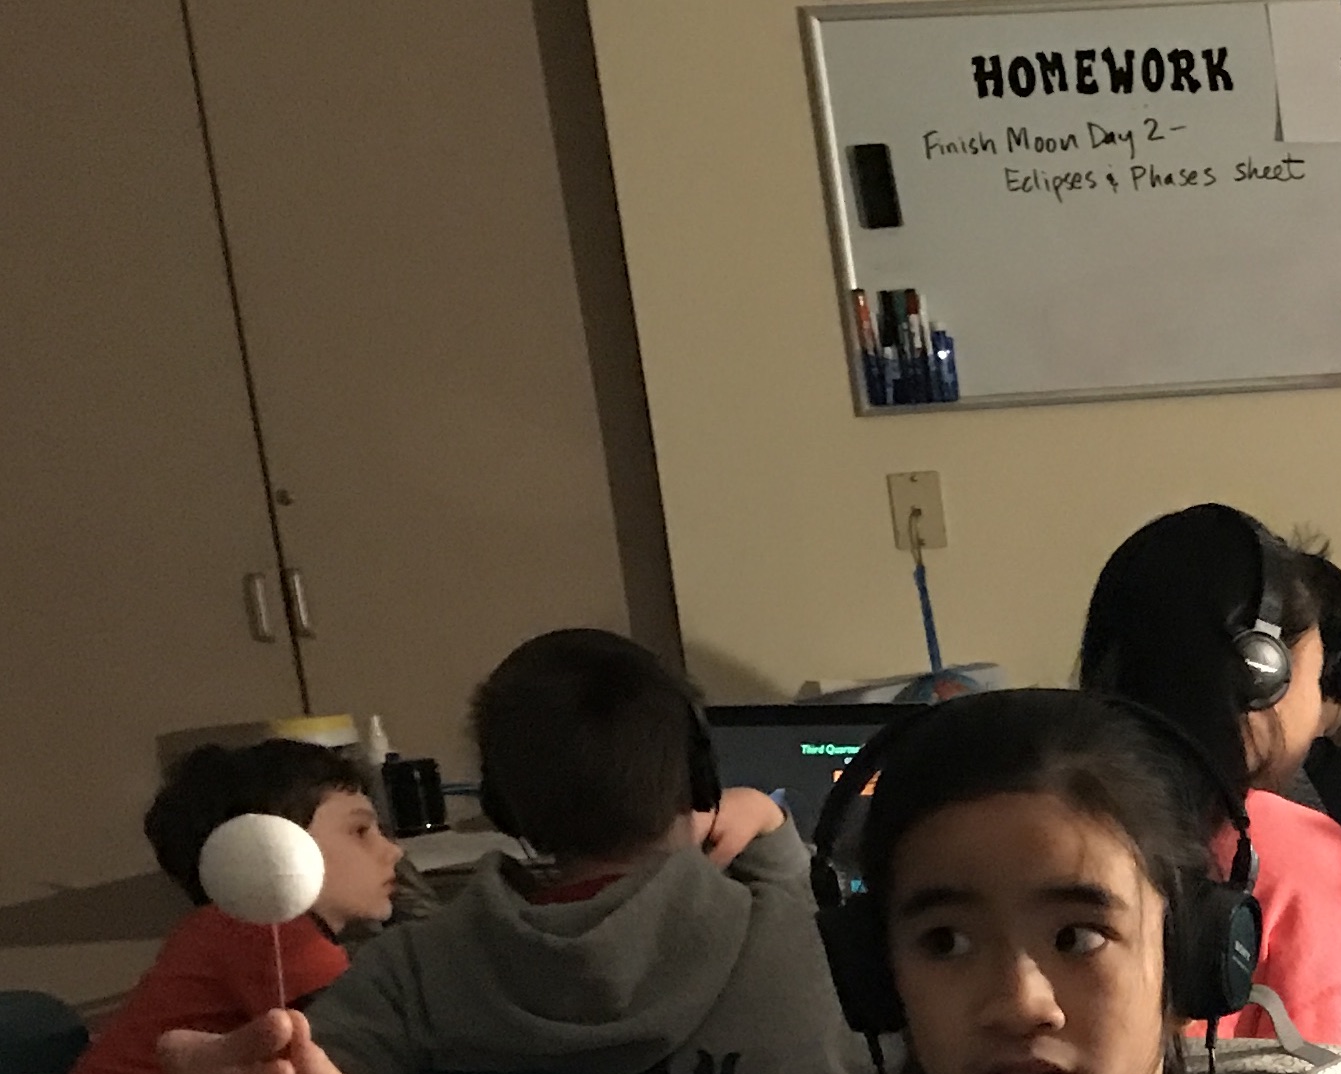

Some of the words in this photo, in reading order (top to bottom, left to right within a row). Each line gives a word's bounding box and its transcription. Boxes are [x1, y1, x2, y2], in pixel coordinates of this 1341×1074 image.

[971, 47, 1234, 98] HOMEWORK
[923, 126, 996, 160] Finish
[1008, 126, 1079, 154] Moon
[1088, 120, 1135, 156] Day
[1005, 166, 1097, 202] Eclipses
[1131, 161, 1217, 188] Phases
[1234, 156, 1307, 184] sheet
